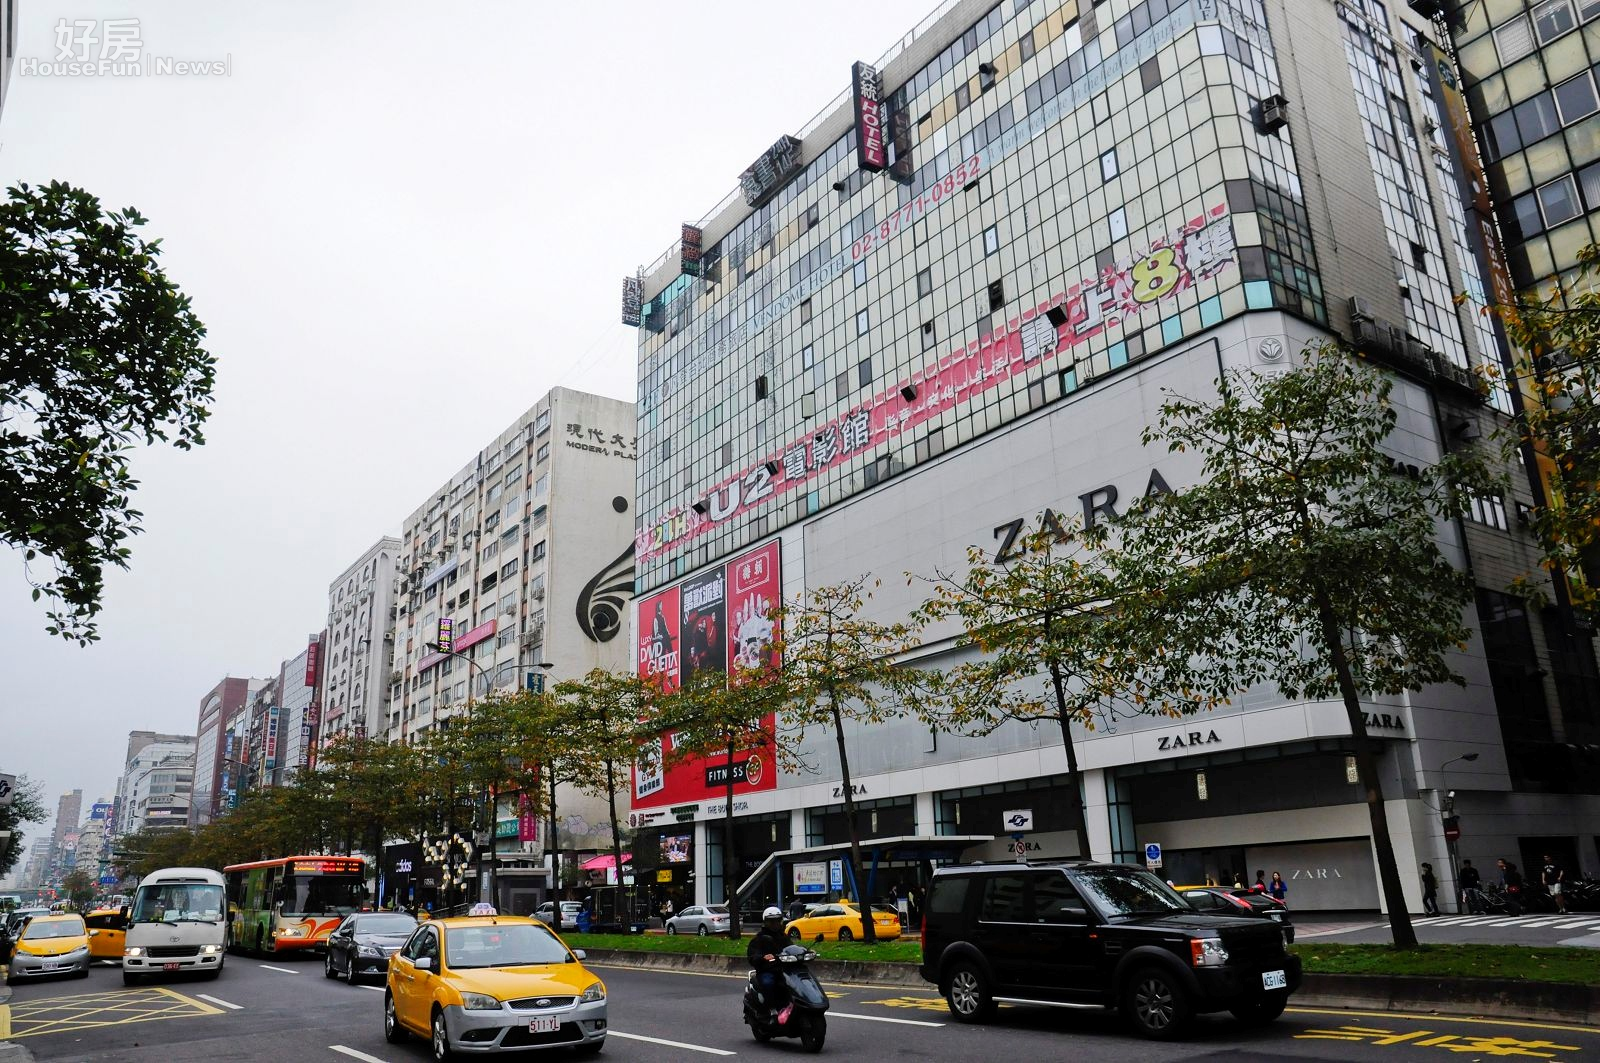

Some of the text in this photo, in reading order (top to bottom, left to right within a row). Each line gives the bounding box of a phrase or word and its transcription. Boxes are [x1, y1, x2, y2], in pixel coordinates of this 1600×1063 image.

[862, 101, 882, 164] HOTEL
[851, 155, 982, 261] 02-8771-0852
[1480, 219, 1502, 271] East
[753, 255, 848, 331] VENDOME HOTEL
[566, 440, 610, 456] MODERN
[783, 409, 871, 481] 電影館
[993, 467, 1176, 565] ZARA
[1361, 712, 1405, 730] ZARA
[1157, 729, 1222, 751] ZARA
[708, 766, 744, 782] FITNSS
[1007, 841, 1042, 853] ZRA
[1291, 867, 1343, 880] ZARA
[530, 1018, 560, 1031] 511-YL
